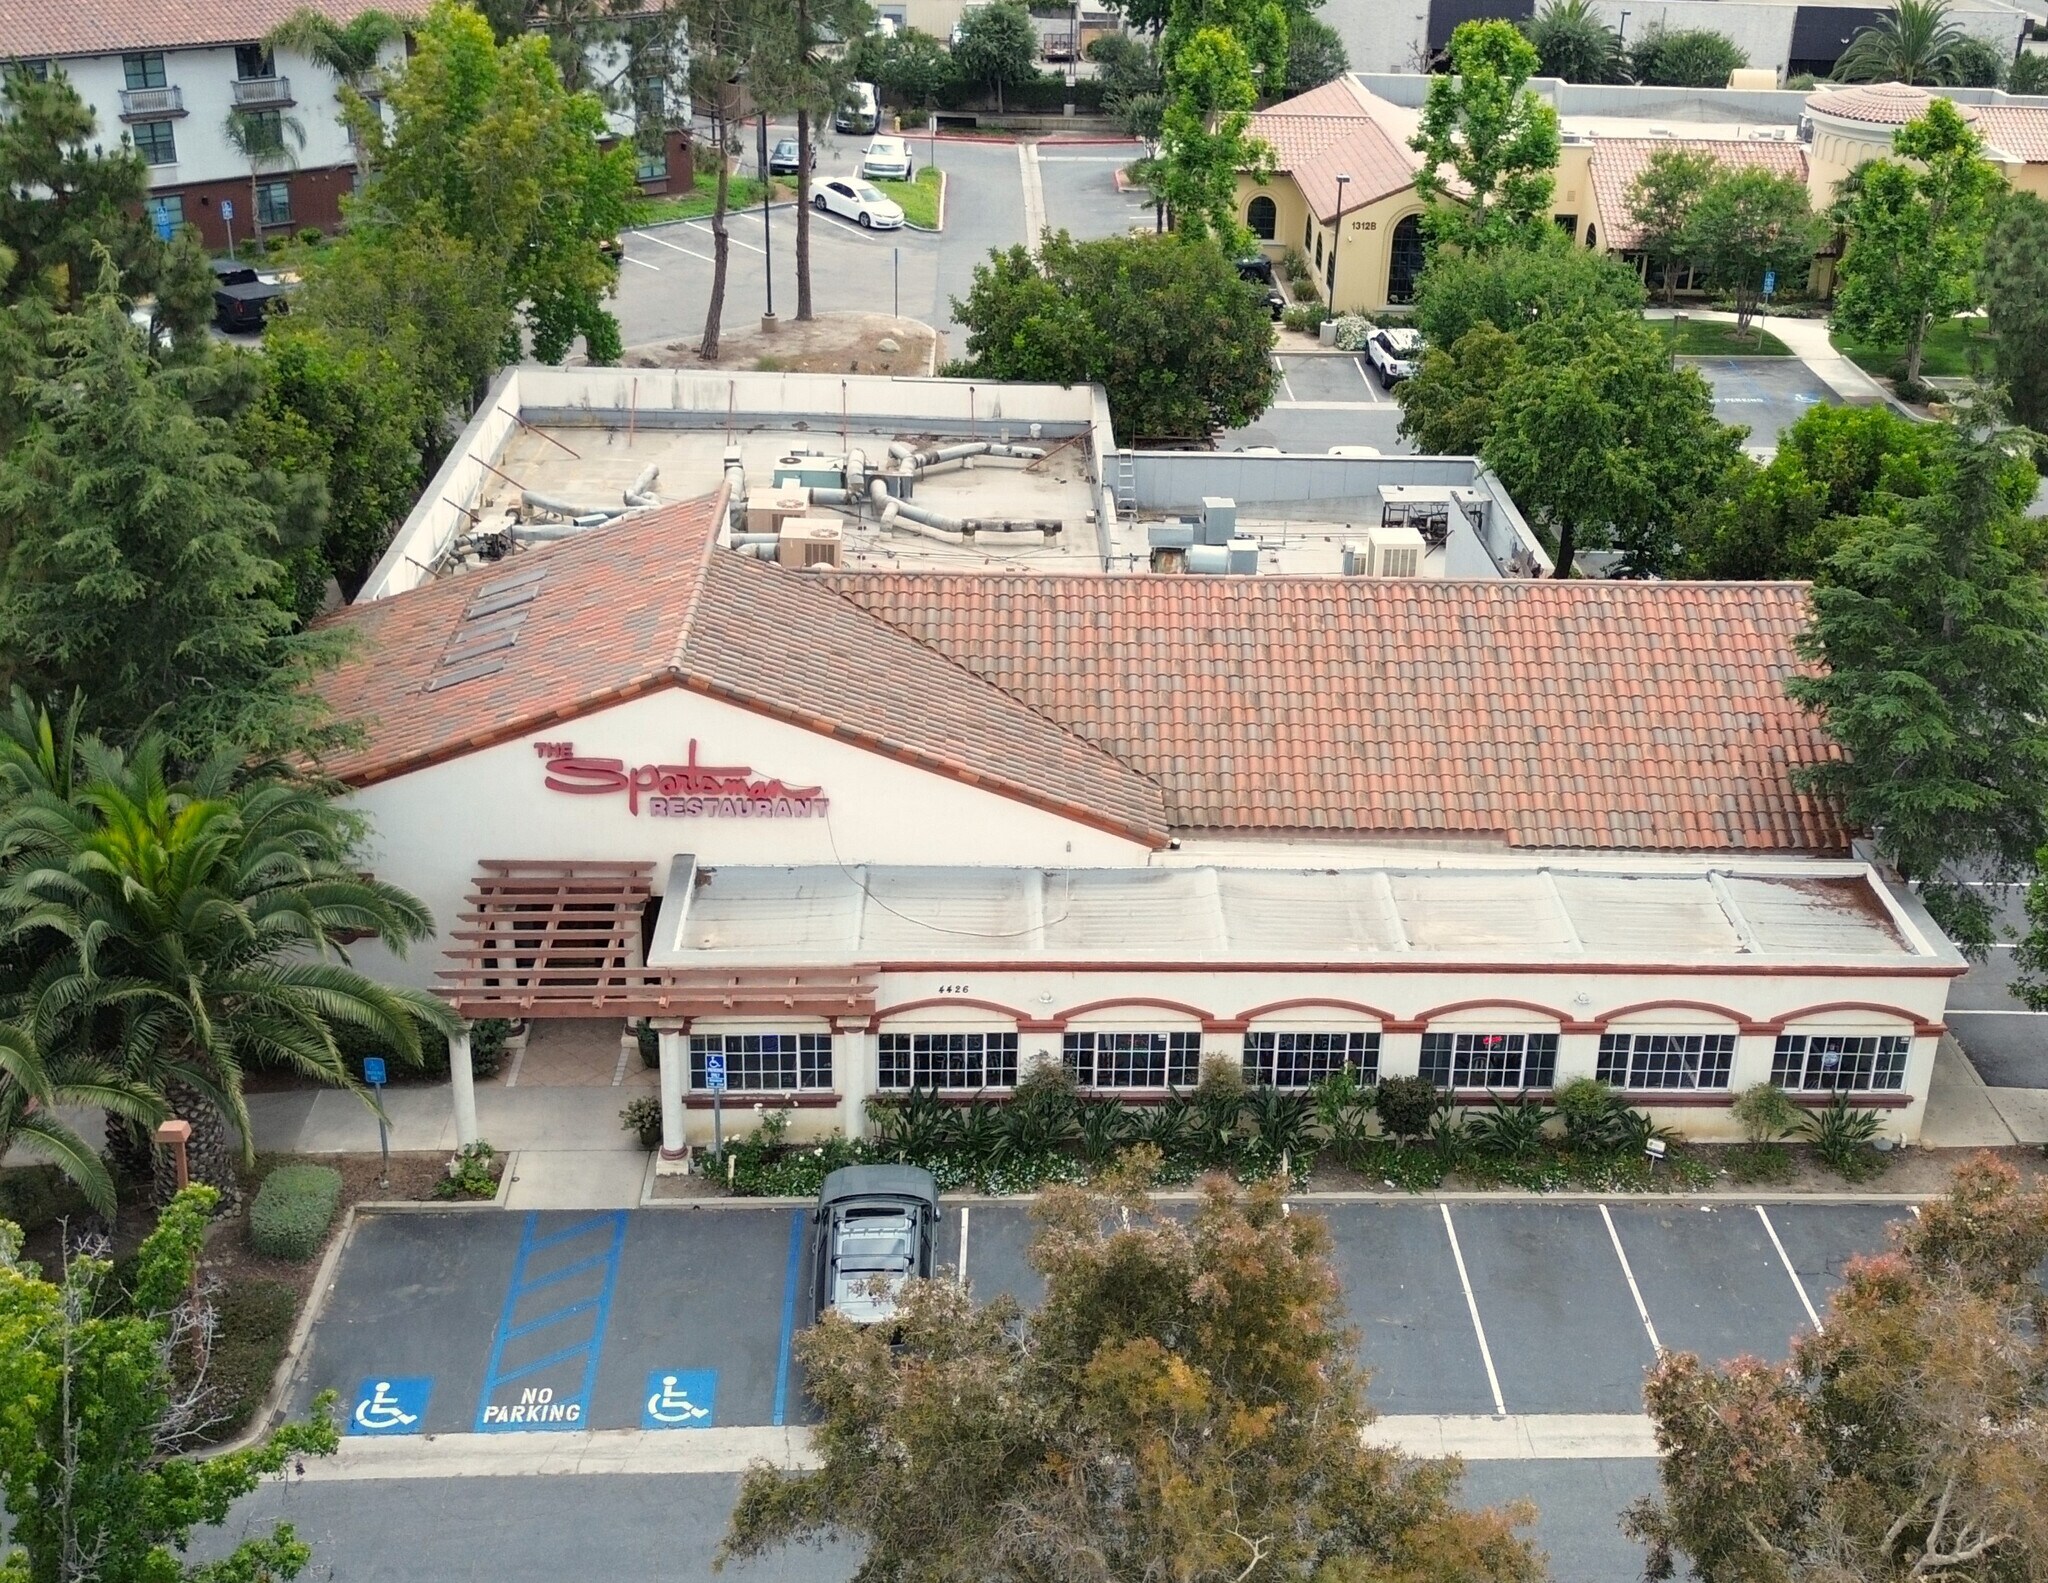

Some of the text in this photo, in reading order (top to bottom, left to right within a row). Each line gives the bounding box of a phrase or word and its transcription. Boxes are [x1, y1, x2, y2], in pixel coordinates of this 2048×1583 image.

[533, 742, 574, 758] THE
[650, 797, 830, 818] RESTAURANT
[938, 985, 969, 994] 4426
[520, 1387, 553, 1405] NO
[483, 1404, 581, 1423] PARKING
